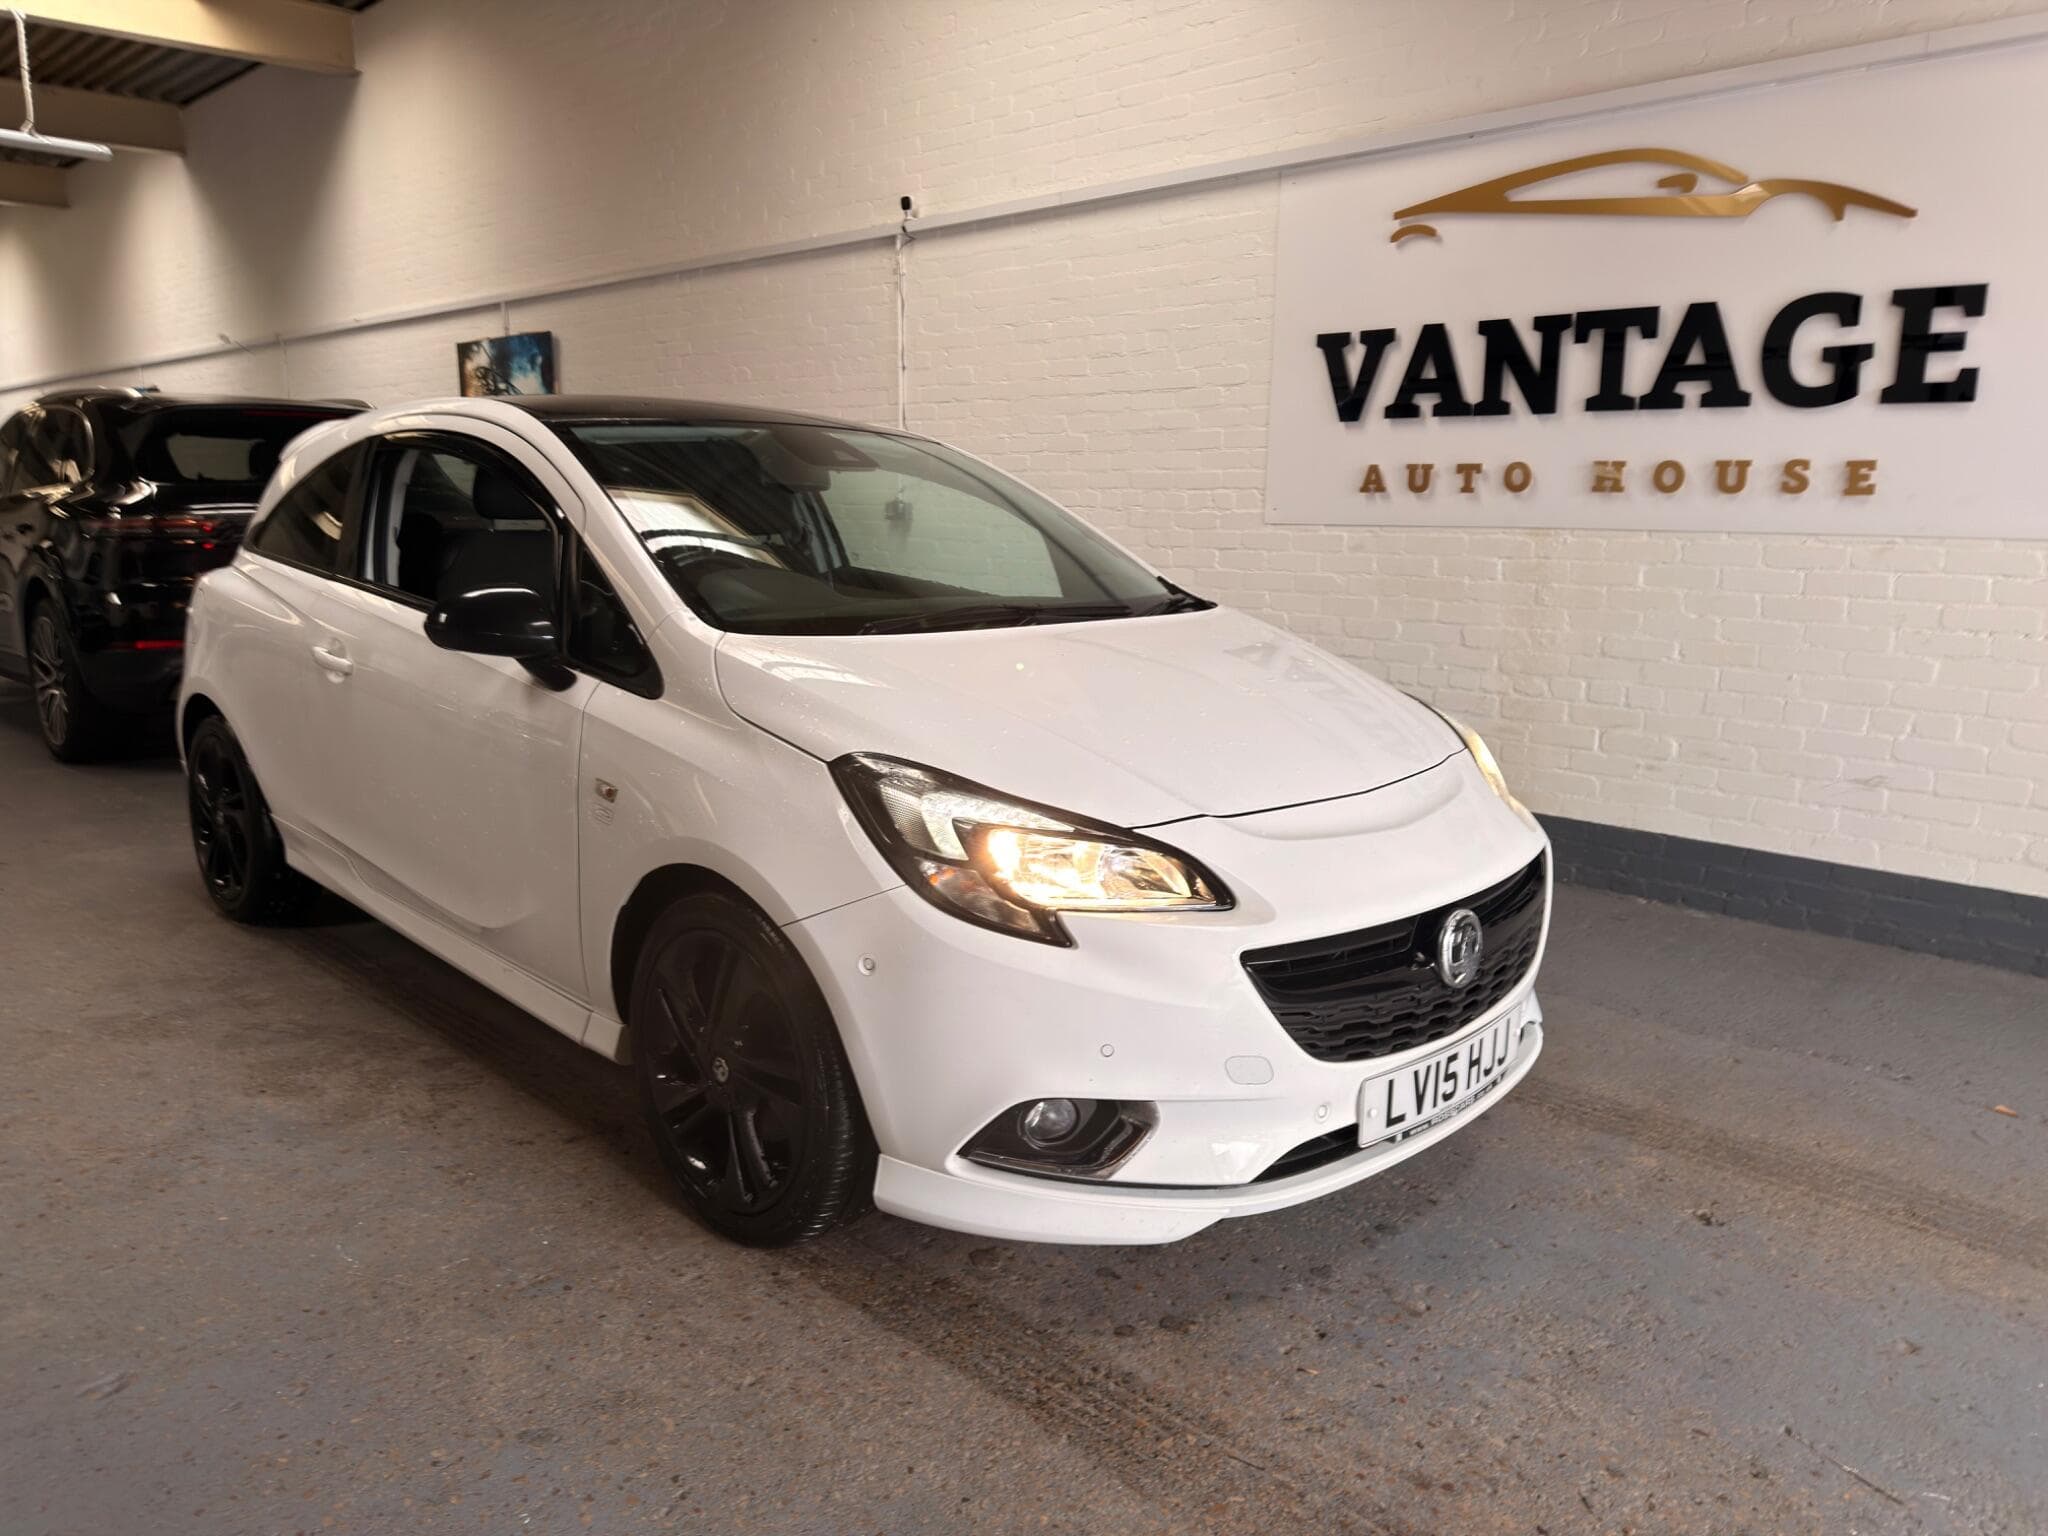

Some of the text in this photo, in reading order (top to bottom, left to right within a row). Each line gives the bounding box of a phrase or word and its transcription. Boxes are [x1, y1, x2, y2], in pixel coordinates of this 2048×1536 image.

[1316, 284, 1989, 422] VANTAGE
[1360, 459, 1878, 496] AUTO HOUSE
[1386, 1052, 1458, 1128] LV15
[1466, 1018, 1511, 1090] HJJ
